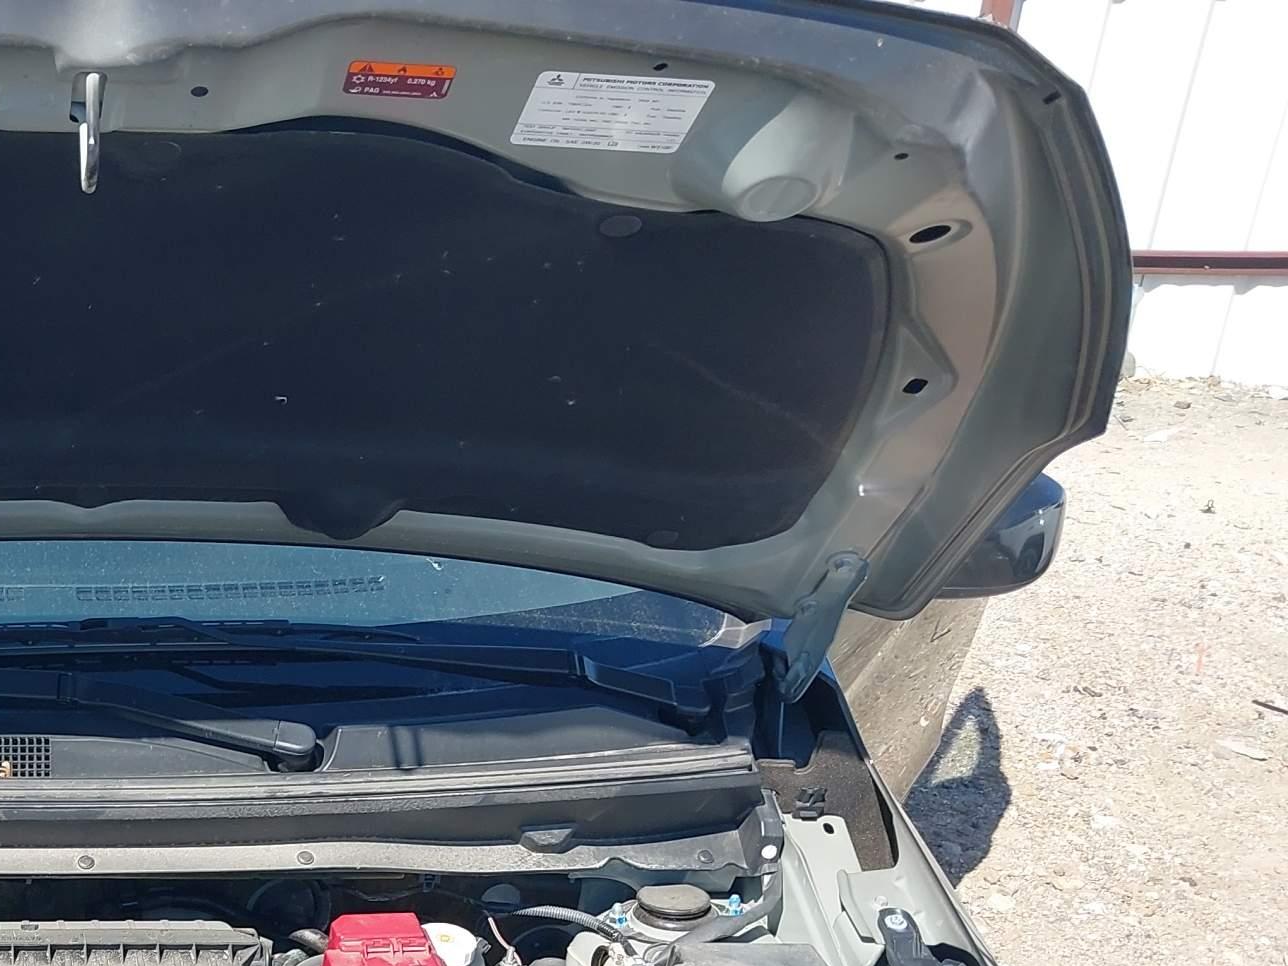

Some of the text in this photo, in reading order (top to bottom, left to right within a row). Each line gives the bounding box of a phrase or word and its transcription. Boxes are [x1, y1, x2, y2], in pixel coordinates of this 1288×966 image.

[367, 76, 399, 84] R-1234yf
[426, 79, 436, 87] kg
[658, 81, 709, 89] CORPORATION
